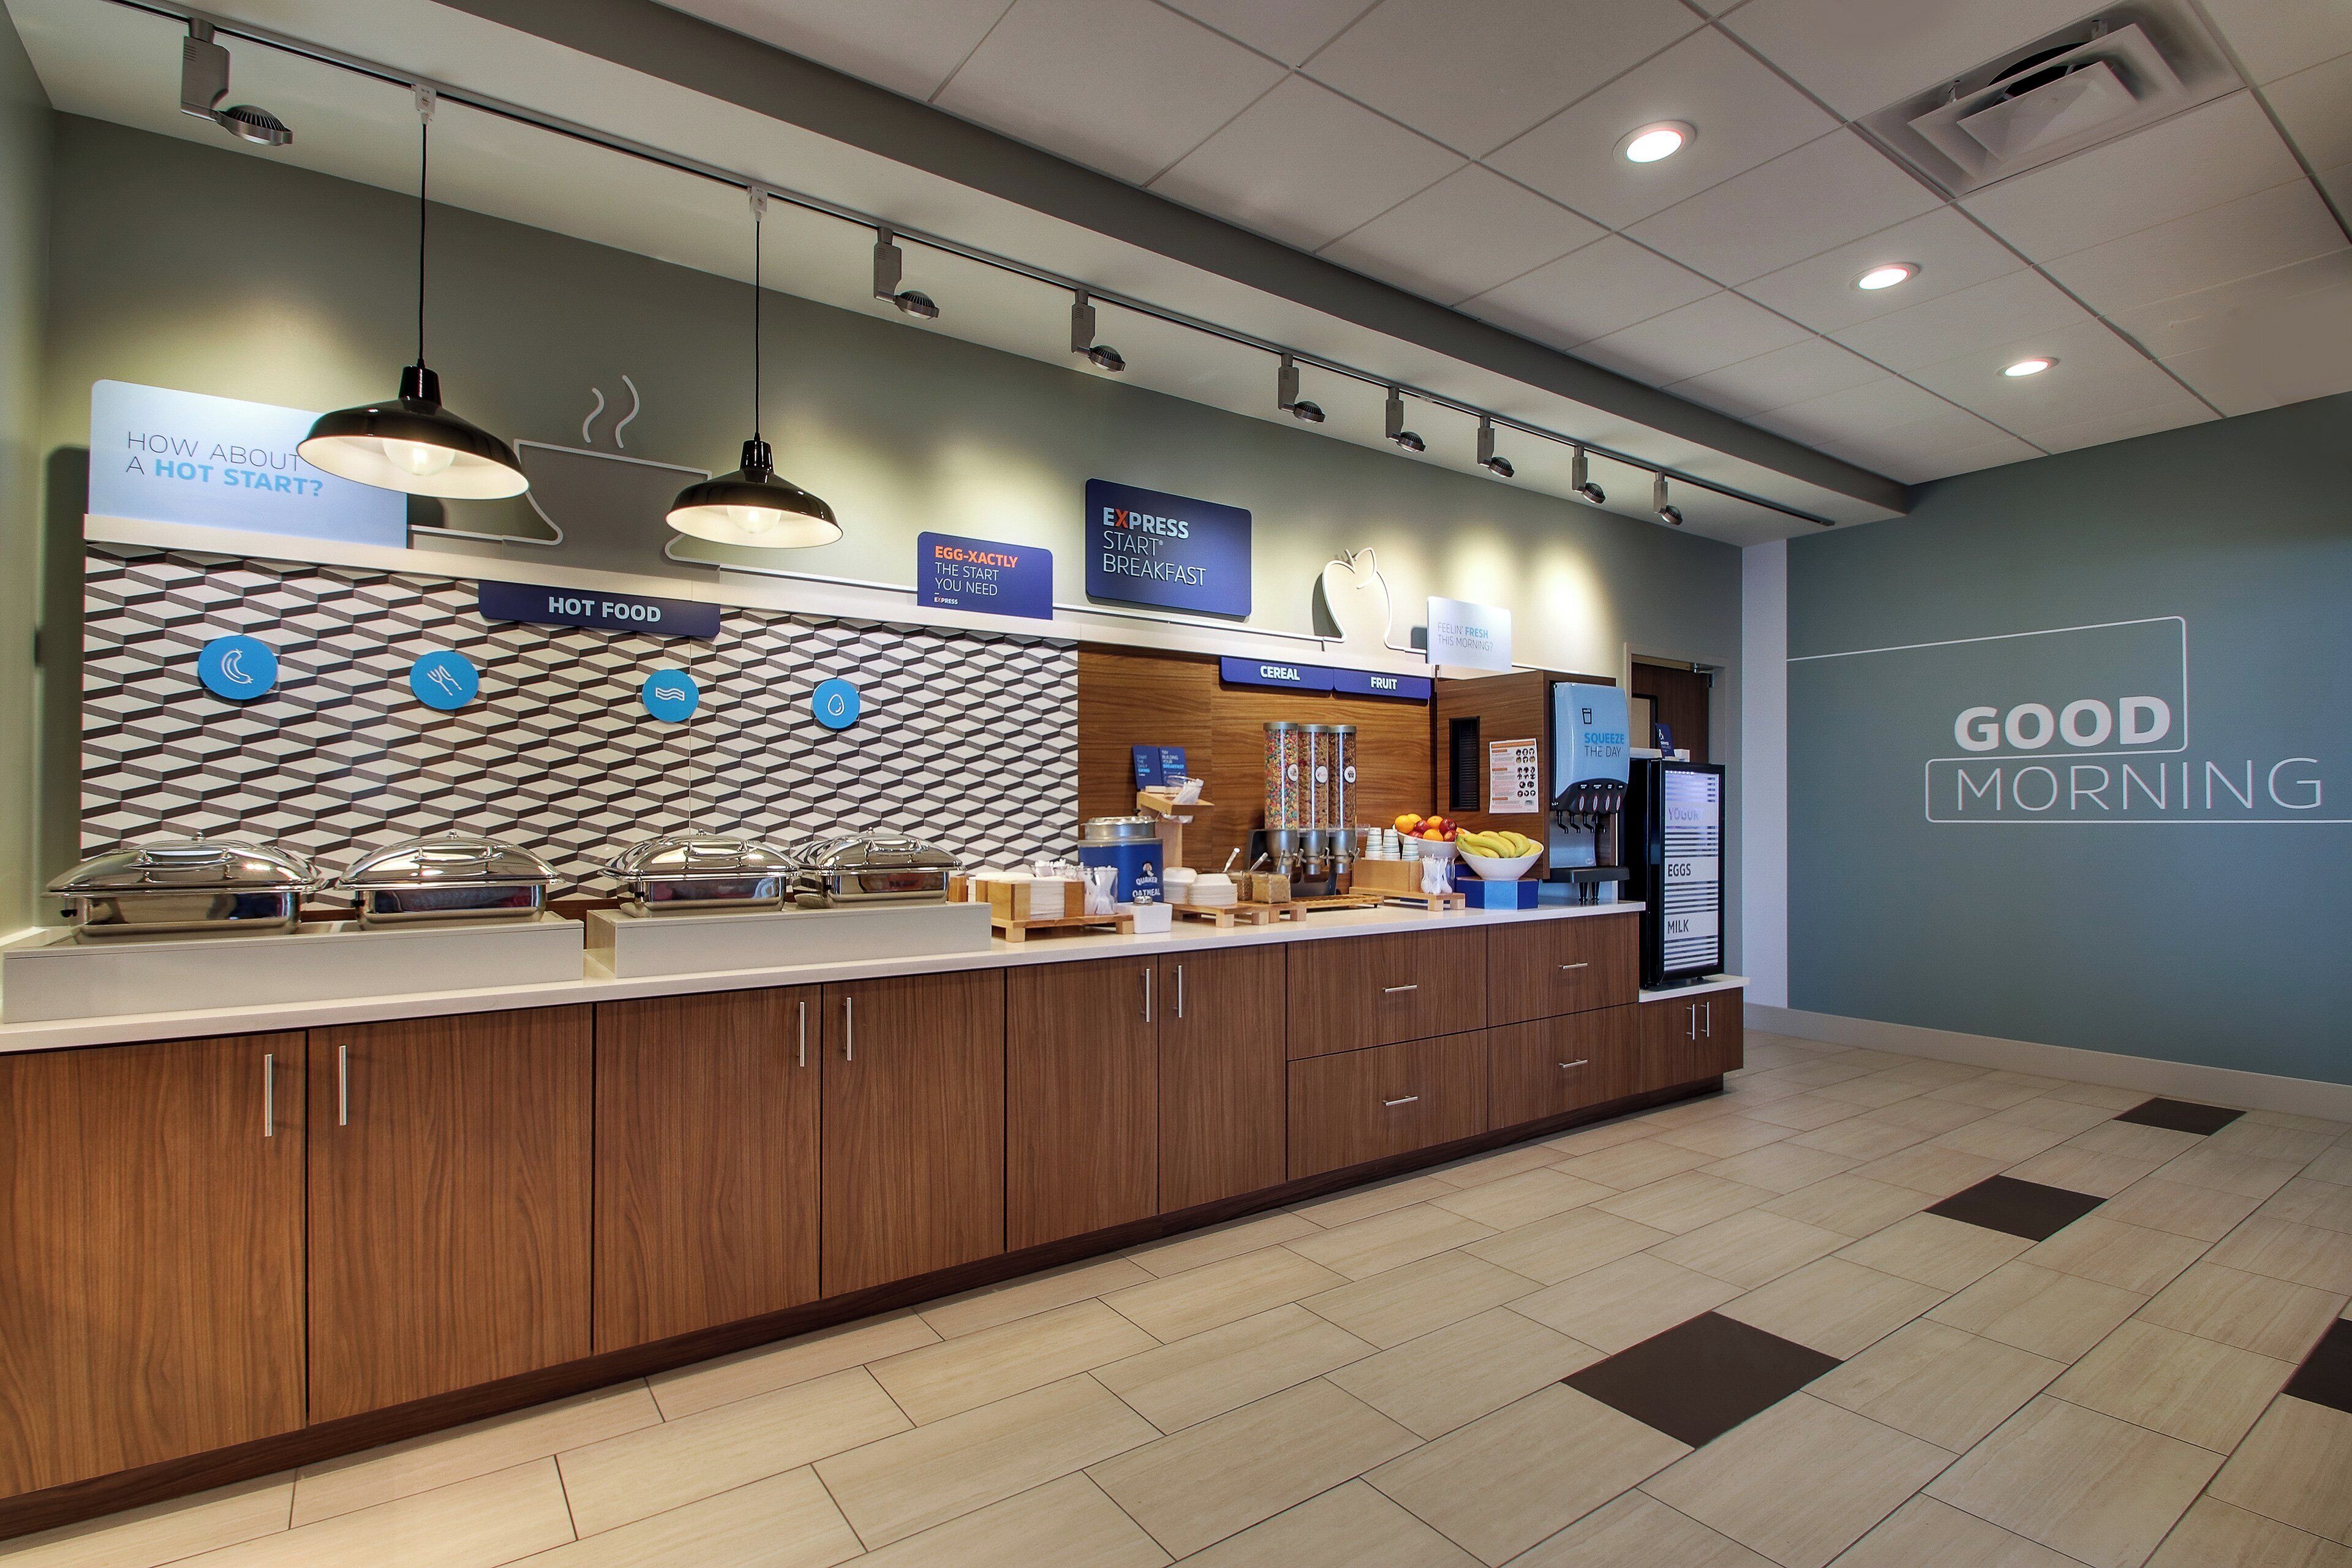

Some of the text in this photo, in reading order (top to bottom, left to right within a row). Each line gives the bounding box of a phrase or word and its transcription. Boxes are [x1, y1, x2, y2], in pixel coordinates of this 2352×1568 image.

[127, 431, 300, 472] HOW ABOUT
[126, 456, 323, 497] A HOT START?
[1103, 507, 1190, 539] EXPRESS
[935, 545, 1019, 568] EGG-XACTLY
[935, 562, 1000, 581] THE START
[1103, 552, 1207, 586] BREAKFAST
[935, 577, 998, 597] YOU NEED
[549, 596, 662, 623] HOT FOOD
[1465, 627, 1489, 639] FRESH
[1438, 634, 1494, 652] THIS MORNING?
[1259, 665, 1301, 682] CEREAL
[1370, 676, 1398, 690] FRUIT
[1954, 695, 2171, 752] GOOD
[1584, 732, 1625, 744] SQUEEZE
[1584, 745, 1622, 758] THE DAY
[1957, 756, 2322, 812] MORNING
[1667, 863, 1691, 877] EGGS
[1136, 876, 1158, 886] QUAKER
[1133, 888, 1161, 897] OATMEAL
[1667, 919, 1689, 934] MILK
